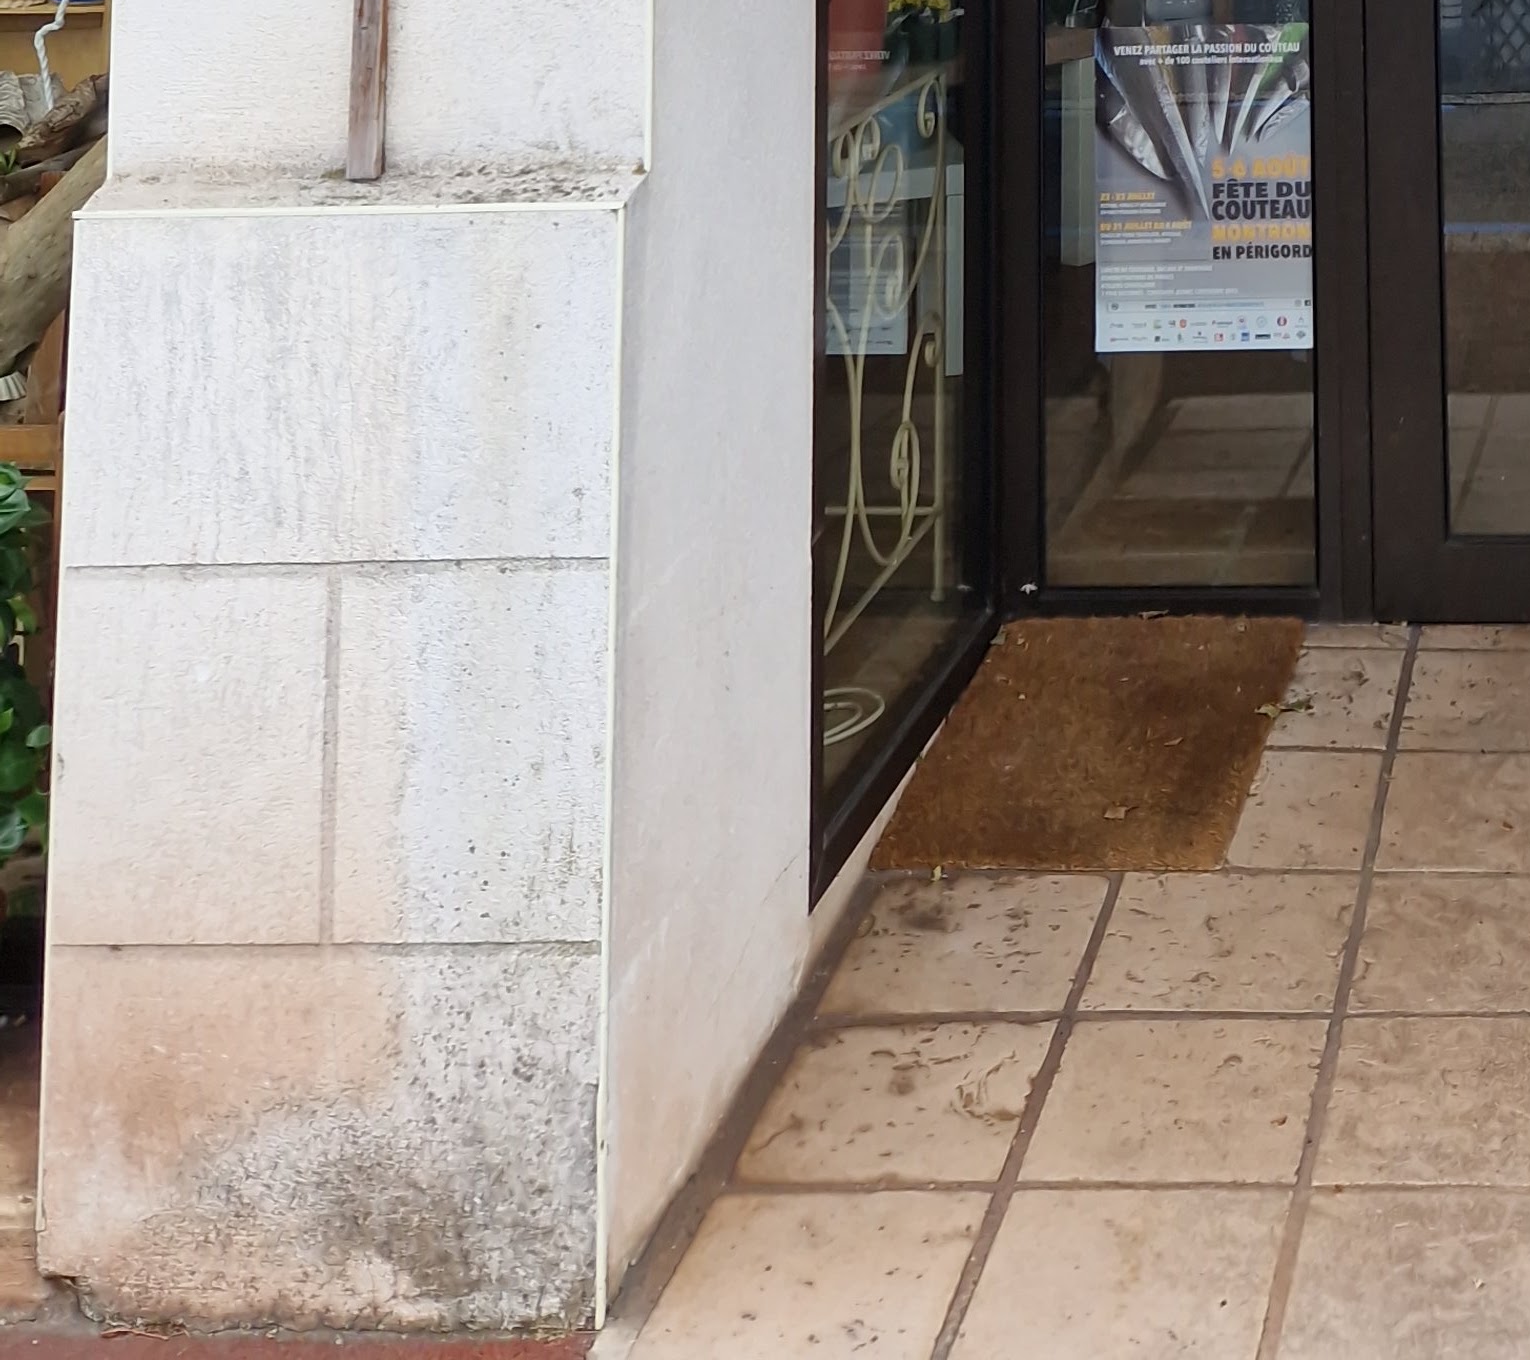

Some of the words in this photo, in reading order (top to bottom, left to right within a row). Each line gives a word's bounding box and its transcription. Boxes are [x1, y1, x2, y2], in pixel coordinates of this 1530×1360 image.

[1114, 45, 1143, 56] VENEZ
[1144, 44, 1189, 55] PARTAGER
[1191, 44, 1203, 54] LA
[1204, 43, 1243, 54] PASSION
[1244, 42, 1257, 53] DU
[1259, 41, 1301, 53] COUTEAU
[1212, 178, 1268, 199] FÊTE
[1276, 181, 1311, 198] DU
[1212, 199, 1311, 221] COUTEAU
[1213, 245, 1232, 260] EN
[1236, 242, 1312, 259] PÉRIGORD
